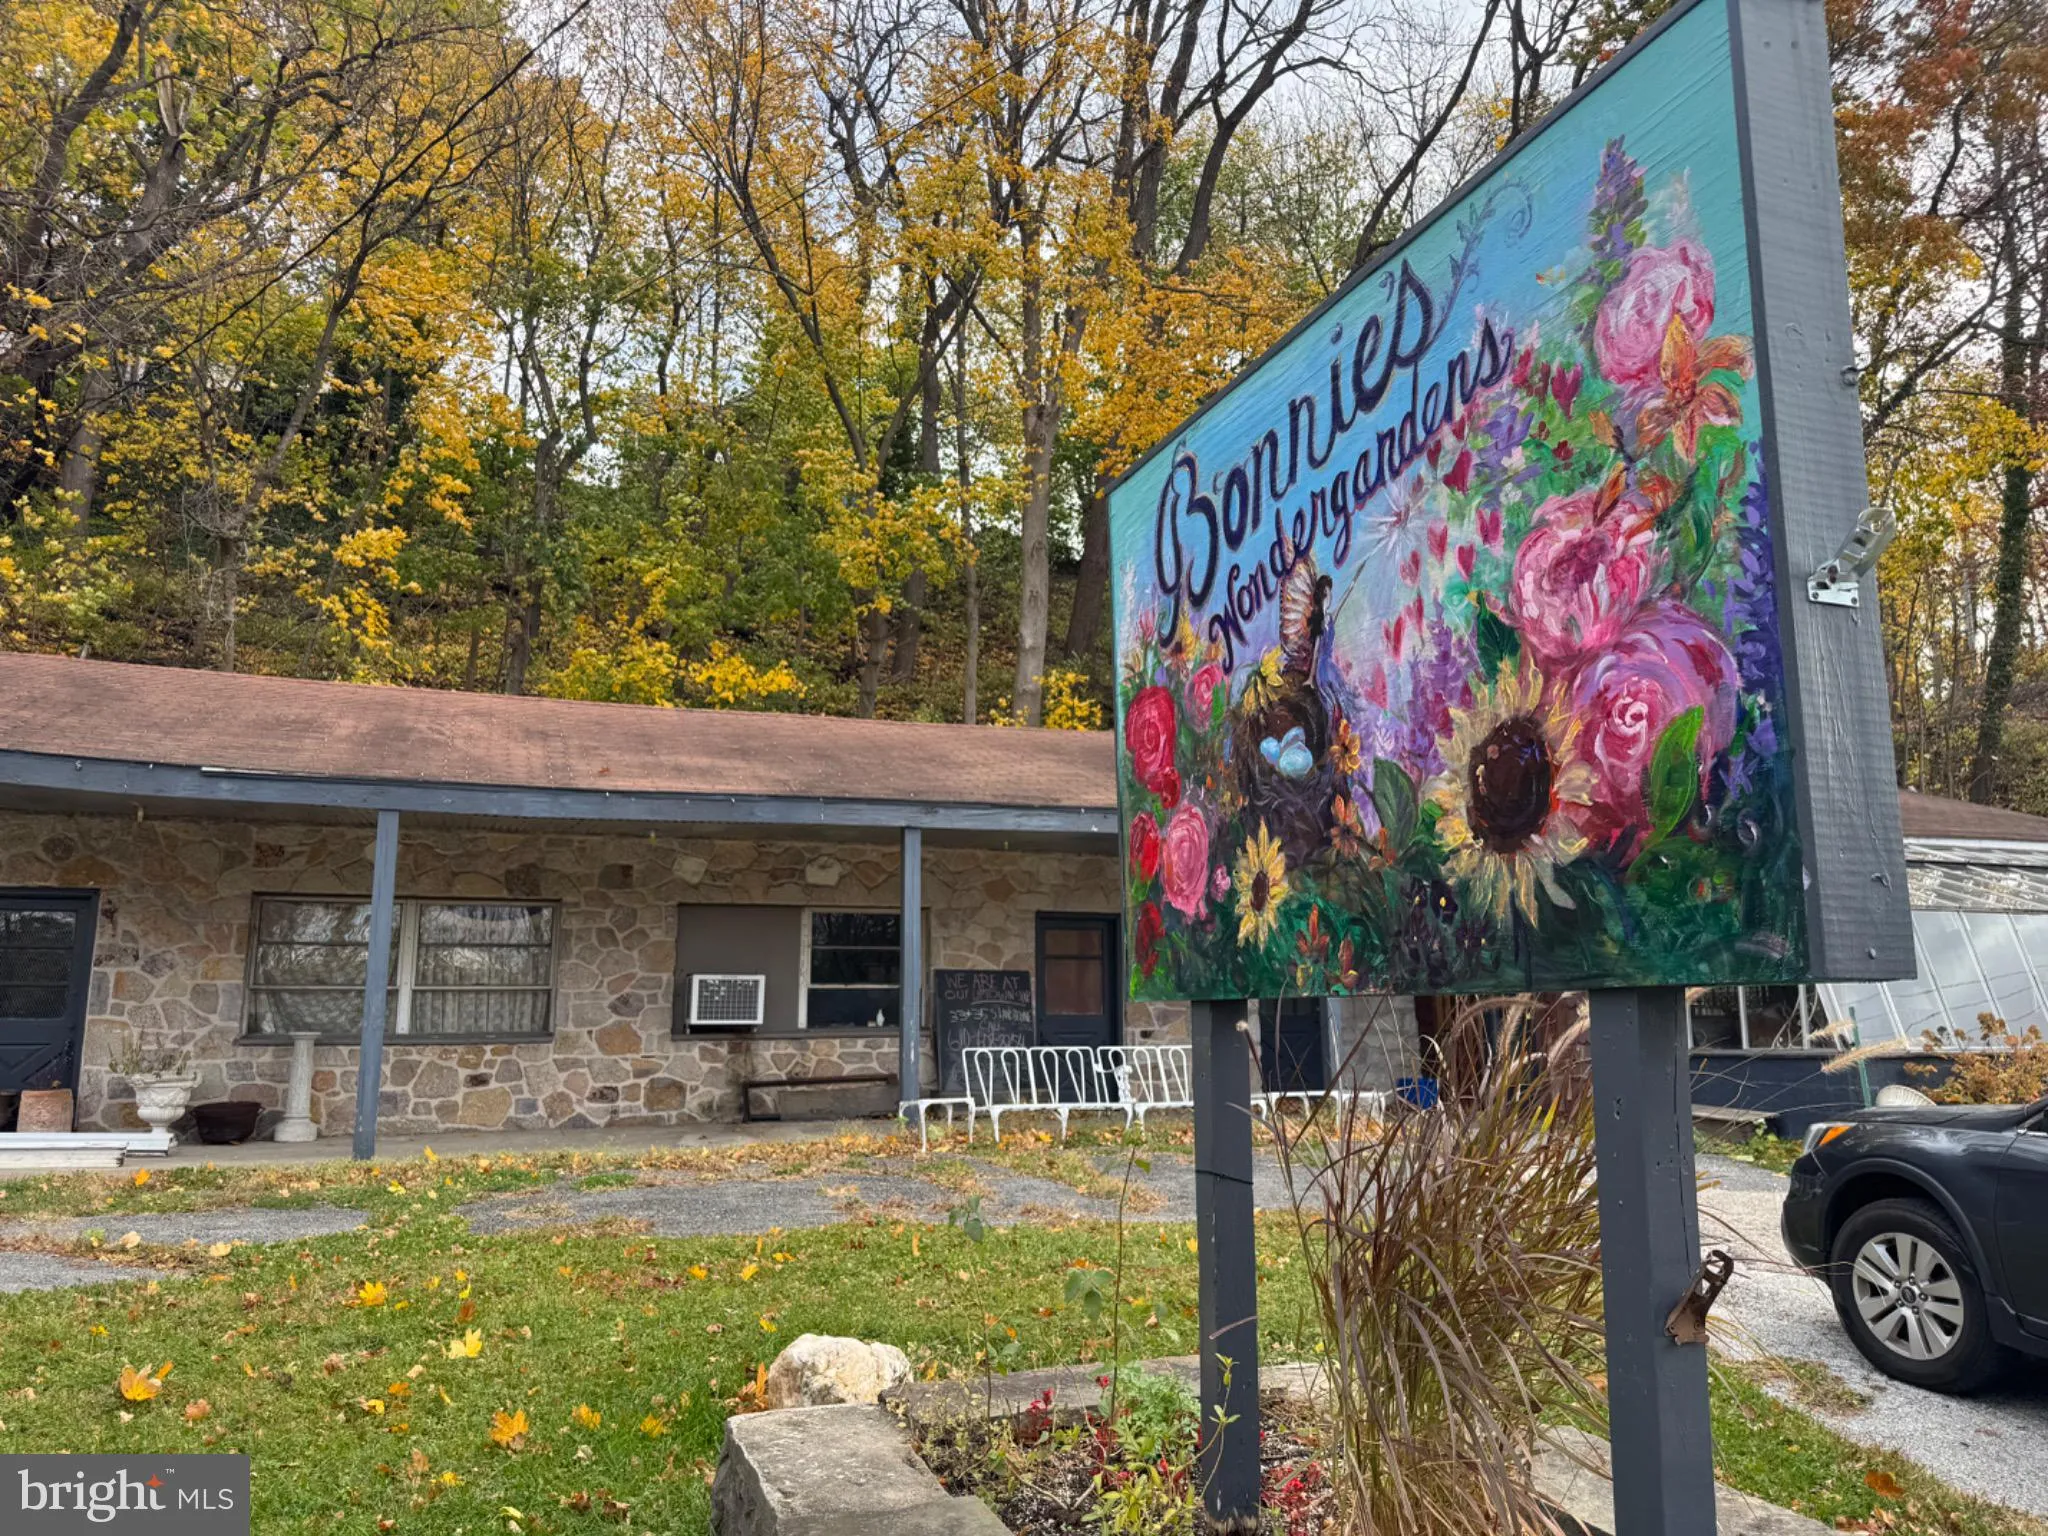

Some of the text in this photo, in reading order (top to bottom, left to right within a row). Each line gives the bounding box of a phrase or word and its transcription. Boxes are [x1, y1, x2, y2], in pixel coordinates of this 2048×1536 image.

[1156, 258, 1435, 649] Bonnie's
[1208, 317, 1515, 675] Wondergardens
[944, 972, 1020, 991] WE ARE AT
